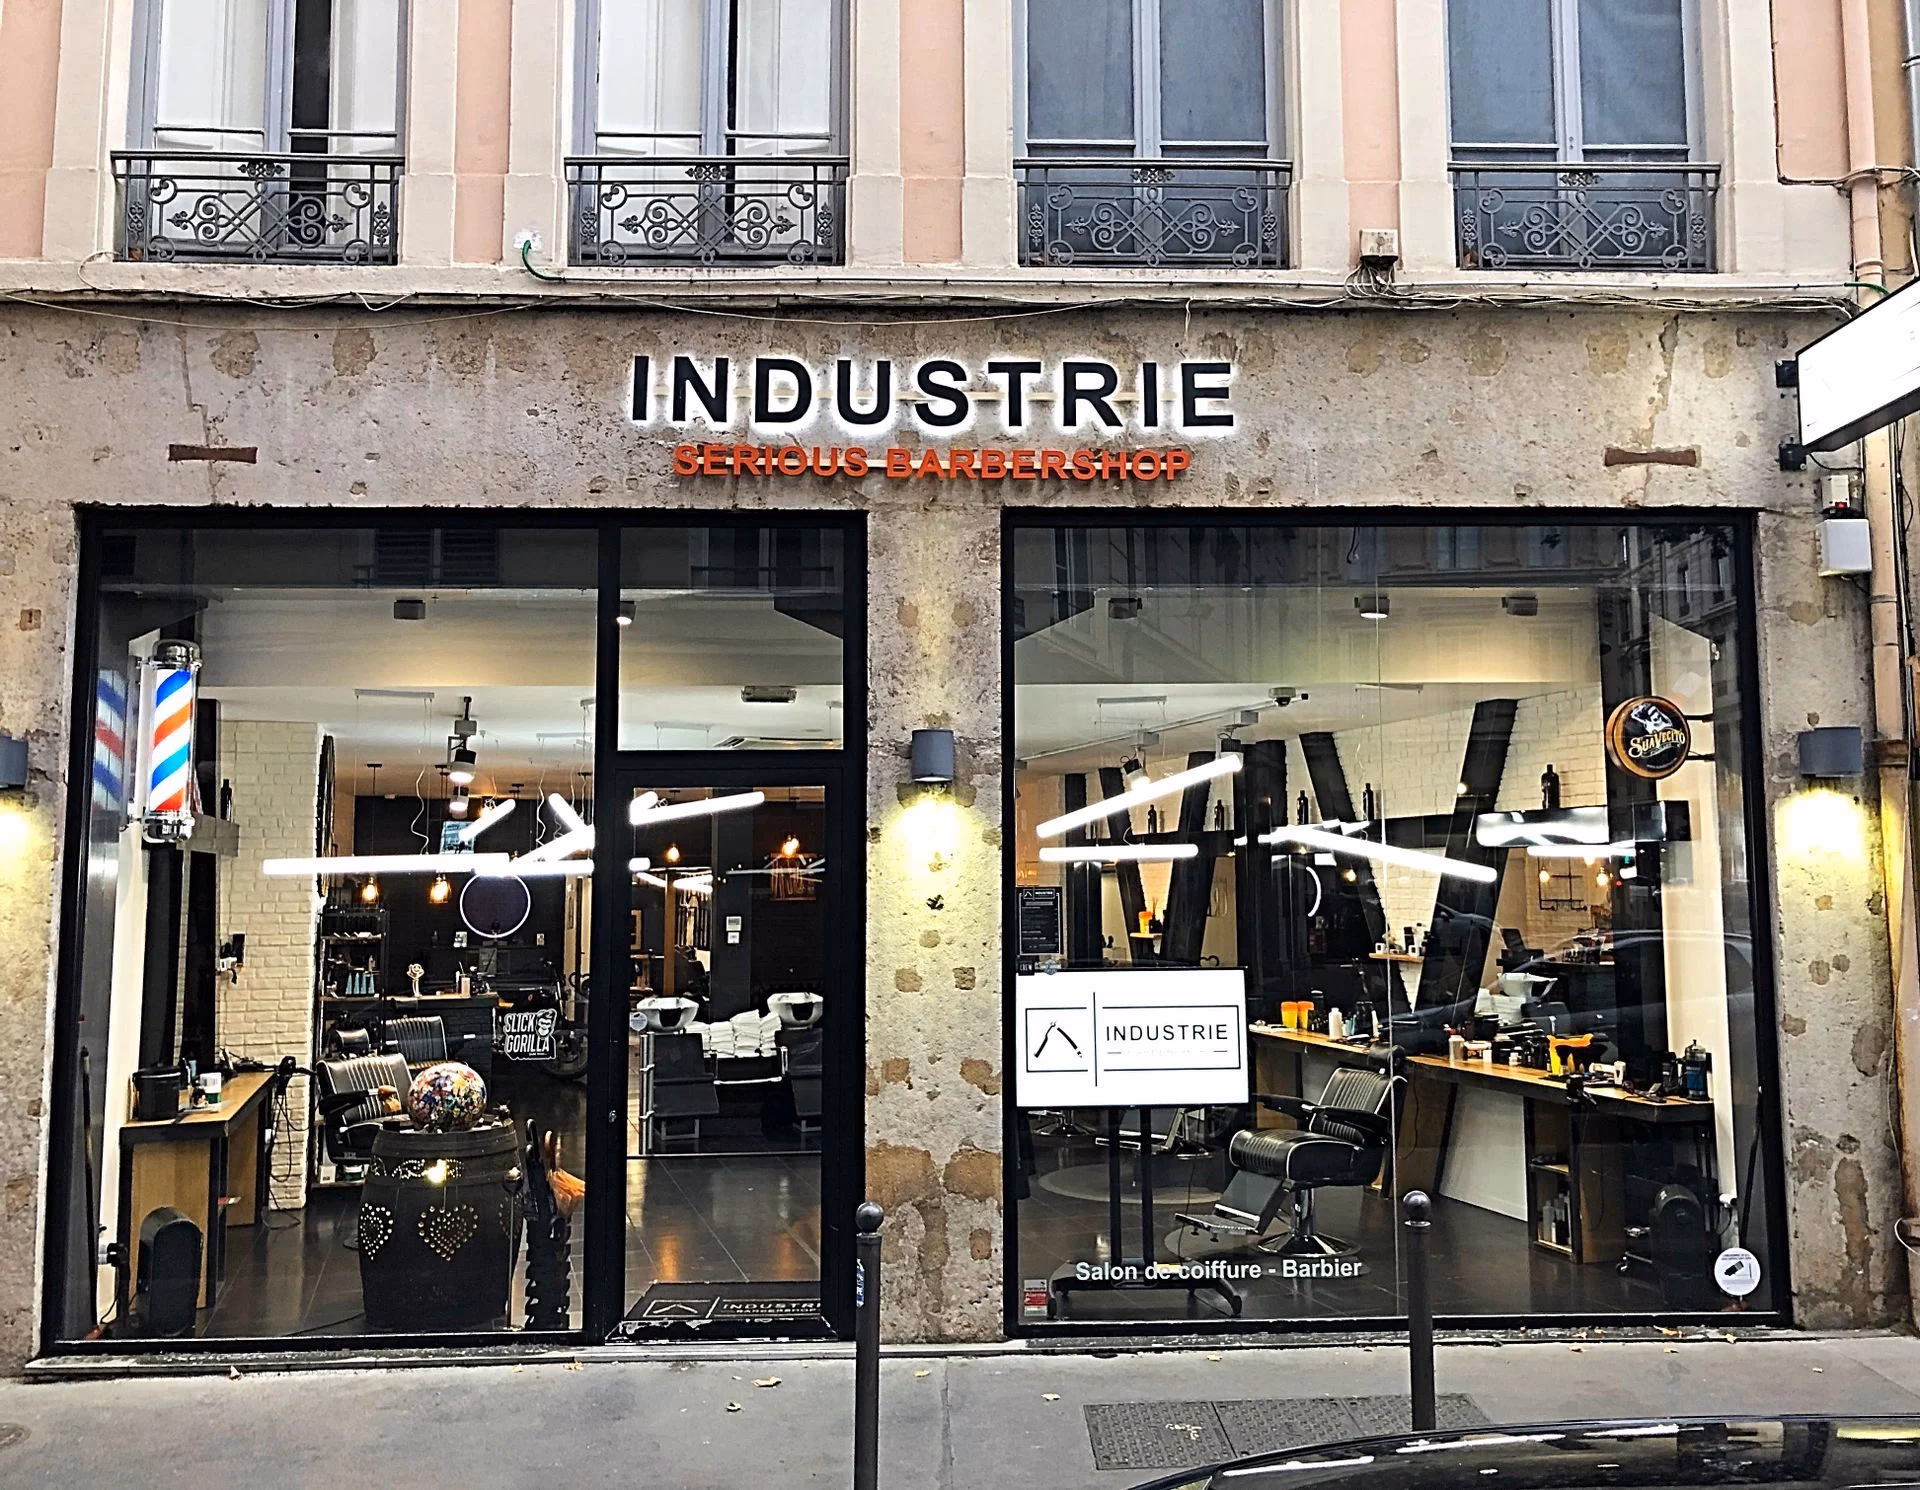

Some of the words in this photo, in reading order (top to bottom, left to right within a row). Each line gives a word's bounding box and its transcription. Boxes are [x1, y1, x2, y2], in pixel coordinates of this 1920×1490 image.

[633, 355, 1234, 428] INDUSTRIE
[674, 444, 870, 477] SERIOUS
[886, 447, 1191, 481] BARBERSHOP
[506, 1014, 536, 1033] SLICK
[1106, 1024, 1228, 1041] INDUSTRIE
[507, 1034, 550, 1053] GORILLA
[1076, 1261, 1138, 1281] Salon
[1144, 1261, 1171, 1280] de
[1179, 1260, 1262, 1280] coiffure
[1282, 1258, 1362, 1278] Barbier
